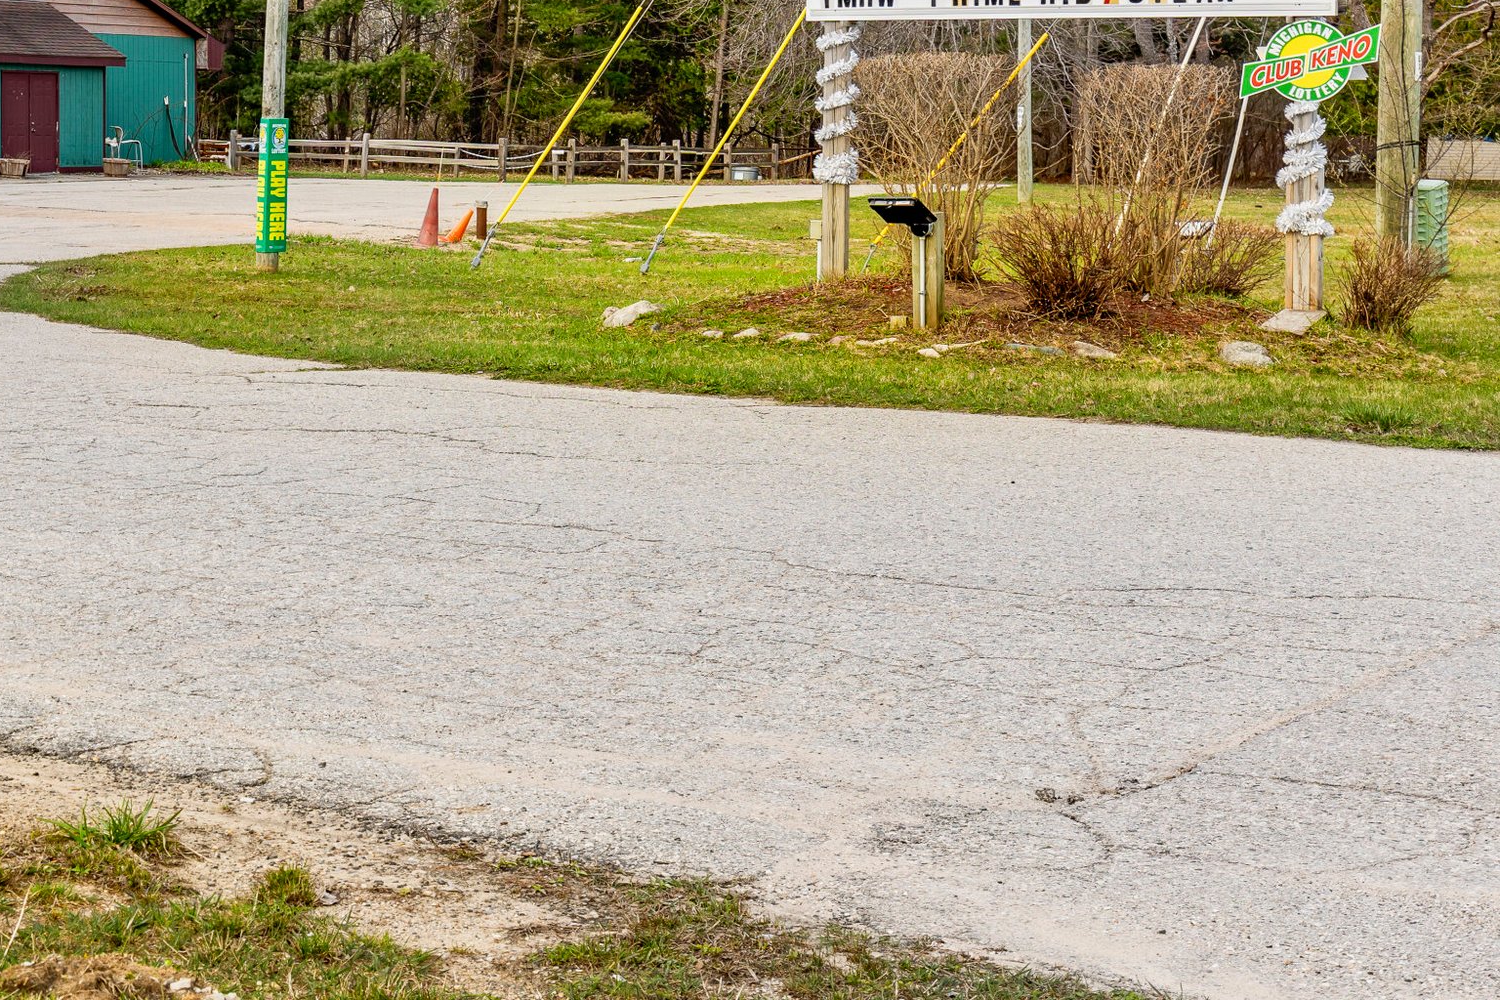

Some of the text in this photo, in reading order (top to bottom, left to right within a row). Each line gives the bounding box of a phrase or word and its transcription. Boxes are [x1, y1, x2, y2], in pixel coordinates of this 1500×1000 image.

[1268, 22, 1334, 57] MICHIGAN
[1250, 33, 1372, 88] CLUB KENO
[1288, 71, 1345, 100] LOTTERY
[270, 160, 286, 198] PLAY
[269, 202, 285, 241] HERE
